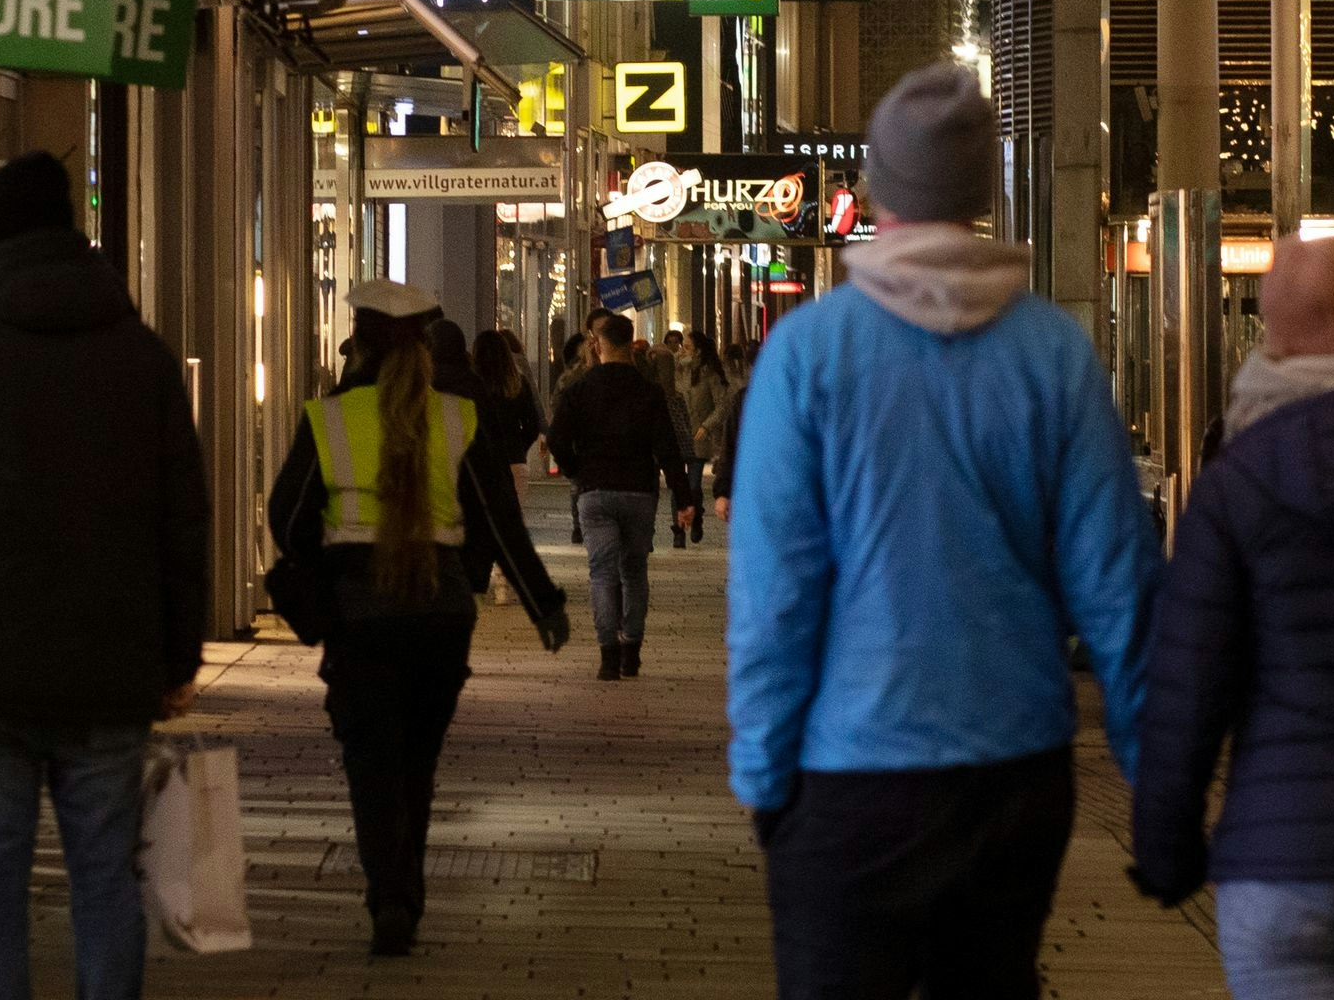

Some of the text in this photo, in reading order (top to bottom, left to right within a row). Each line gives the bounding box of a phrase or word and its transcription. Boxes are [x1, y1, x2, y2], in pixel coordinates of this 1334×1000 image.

[626, 79, 676, 122] Z
[783, 143, 871, 160] ESPRIT
[368, 174, 558, 193] www.villgraternatur.at
[704, 203, 753, 211] FOR YOU
